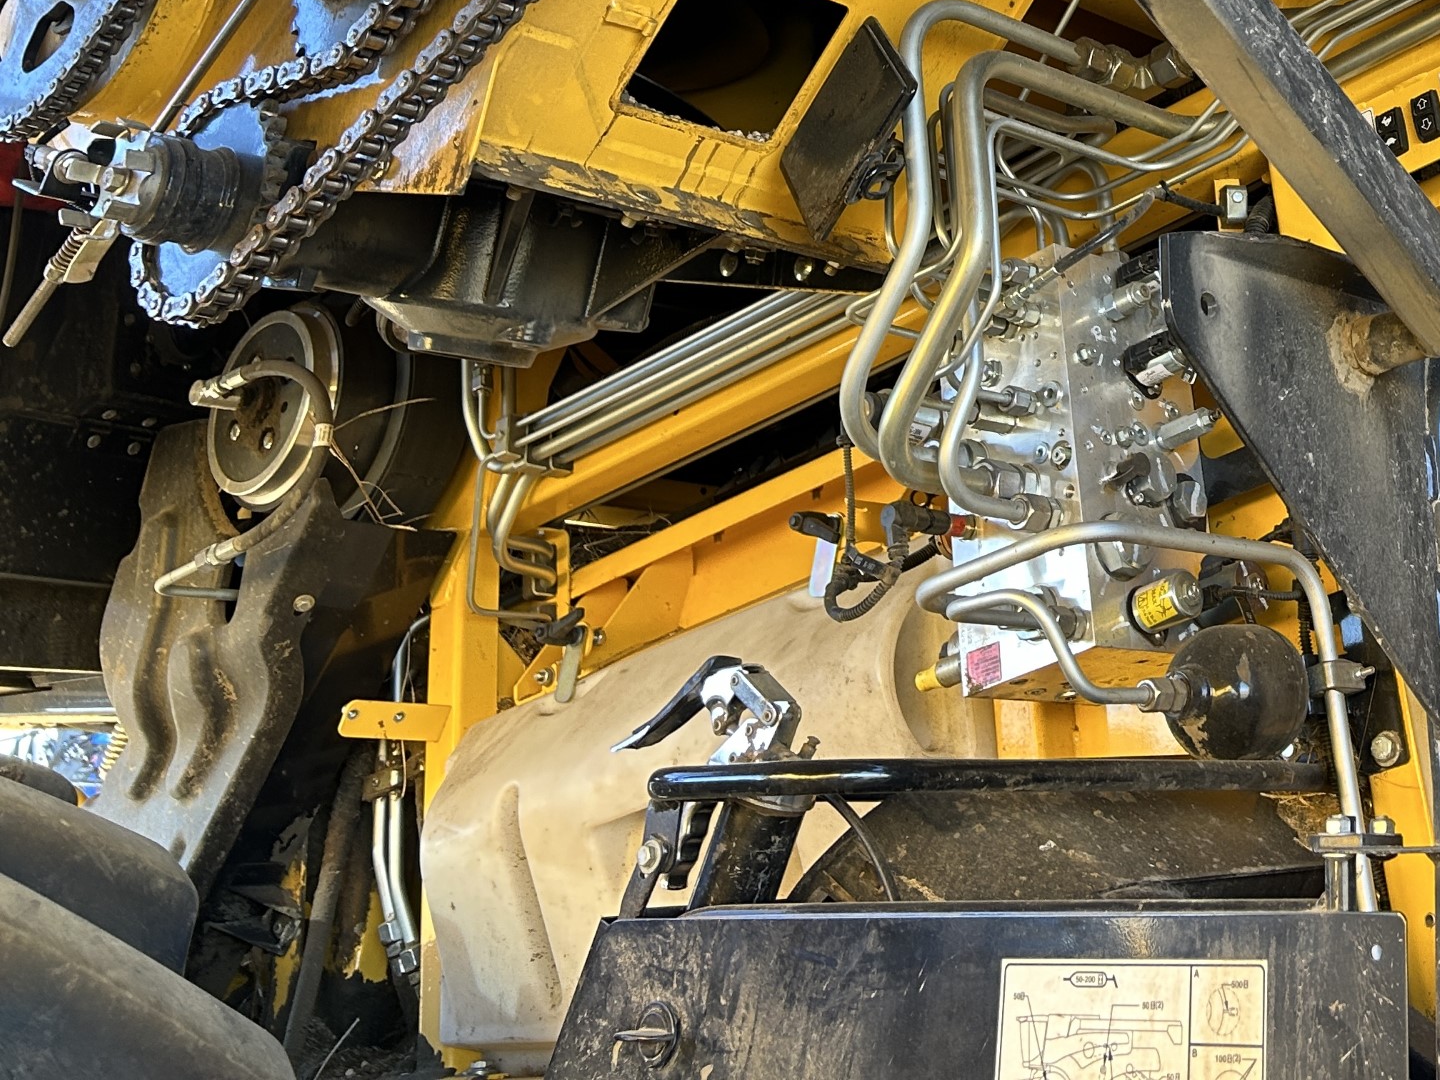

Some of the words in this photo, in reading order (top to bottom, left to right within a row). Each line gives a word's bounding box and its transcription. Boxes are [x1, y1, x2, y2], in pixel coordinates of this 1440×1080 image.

[1193, 968, 1200, 978] A
[1075, 975, 1096, 984] 50-200
[1191, 1048, 1198, 1058] B
